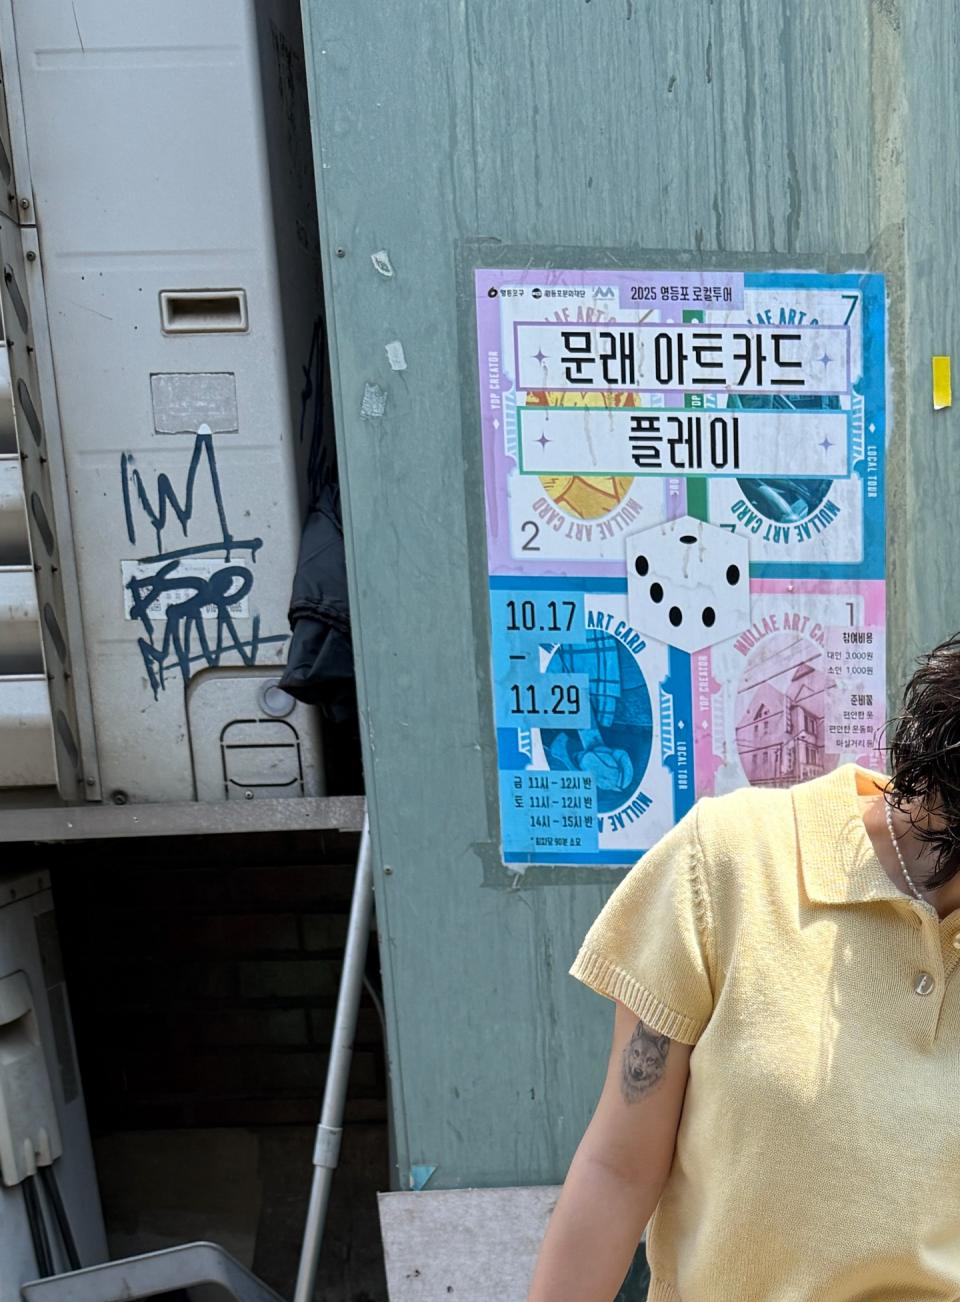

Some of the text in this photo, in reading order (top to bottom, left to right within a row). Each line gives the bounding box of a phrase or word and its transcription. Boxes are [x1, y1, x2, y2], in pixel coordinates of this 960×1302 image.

[630, 286, 657, 300] 2025
[660, 286, 690, 301] 영등포
[692, 286, 732, 302] 로컬투어
[560, 331, 805, 386] 문래 아트카드
[628, 416, 740, 470] 플레이
[532, 497, 566, 532] CARD
[730, 499, 763, 534] CARD
[521, 520, 541, 551] 2
[565, 521, 593, 542] ART
[763, 523, 791, 545] ART
[506, 600, 576, 631] 10.17
[783, 611, 810, 633] ART
[587, 610, 647, 655] ART CARD
[511, 684, 580, 715] 11.29
[514, 776, 523, 789] 금
[528, 776, 549, 790] 11시
[561, 777, 581, 790] 12시
[583, 777, 592, 790] 반
[514, 795, 524, 808] 토
[530, 796, 550, 809] 11시
[562, 796, 582, 809] 12시
[584, 796, 593, 809] 반
[530, 815, 551, 828] 14시
[562, 815, 582, 828] 15시
[584, 815, 593, 829] 반
